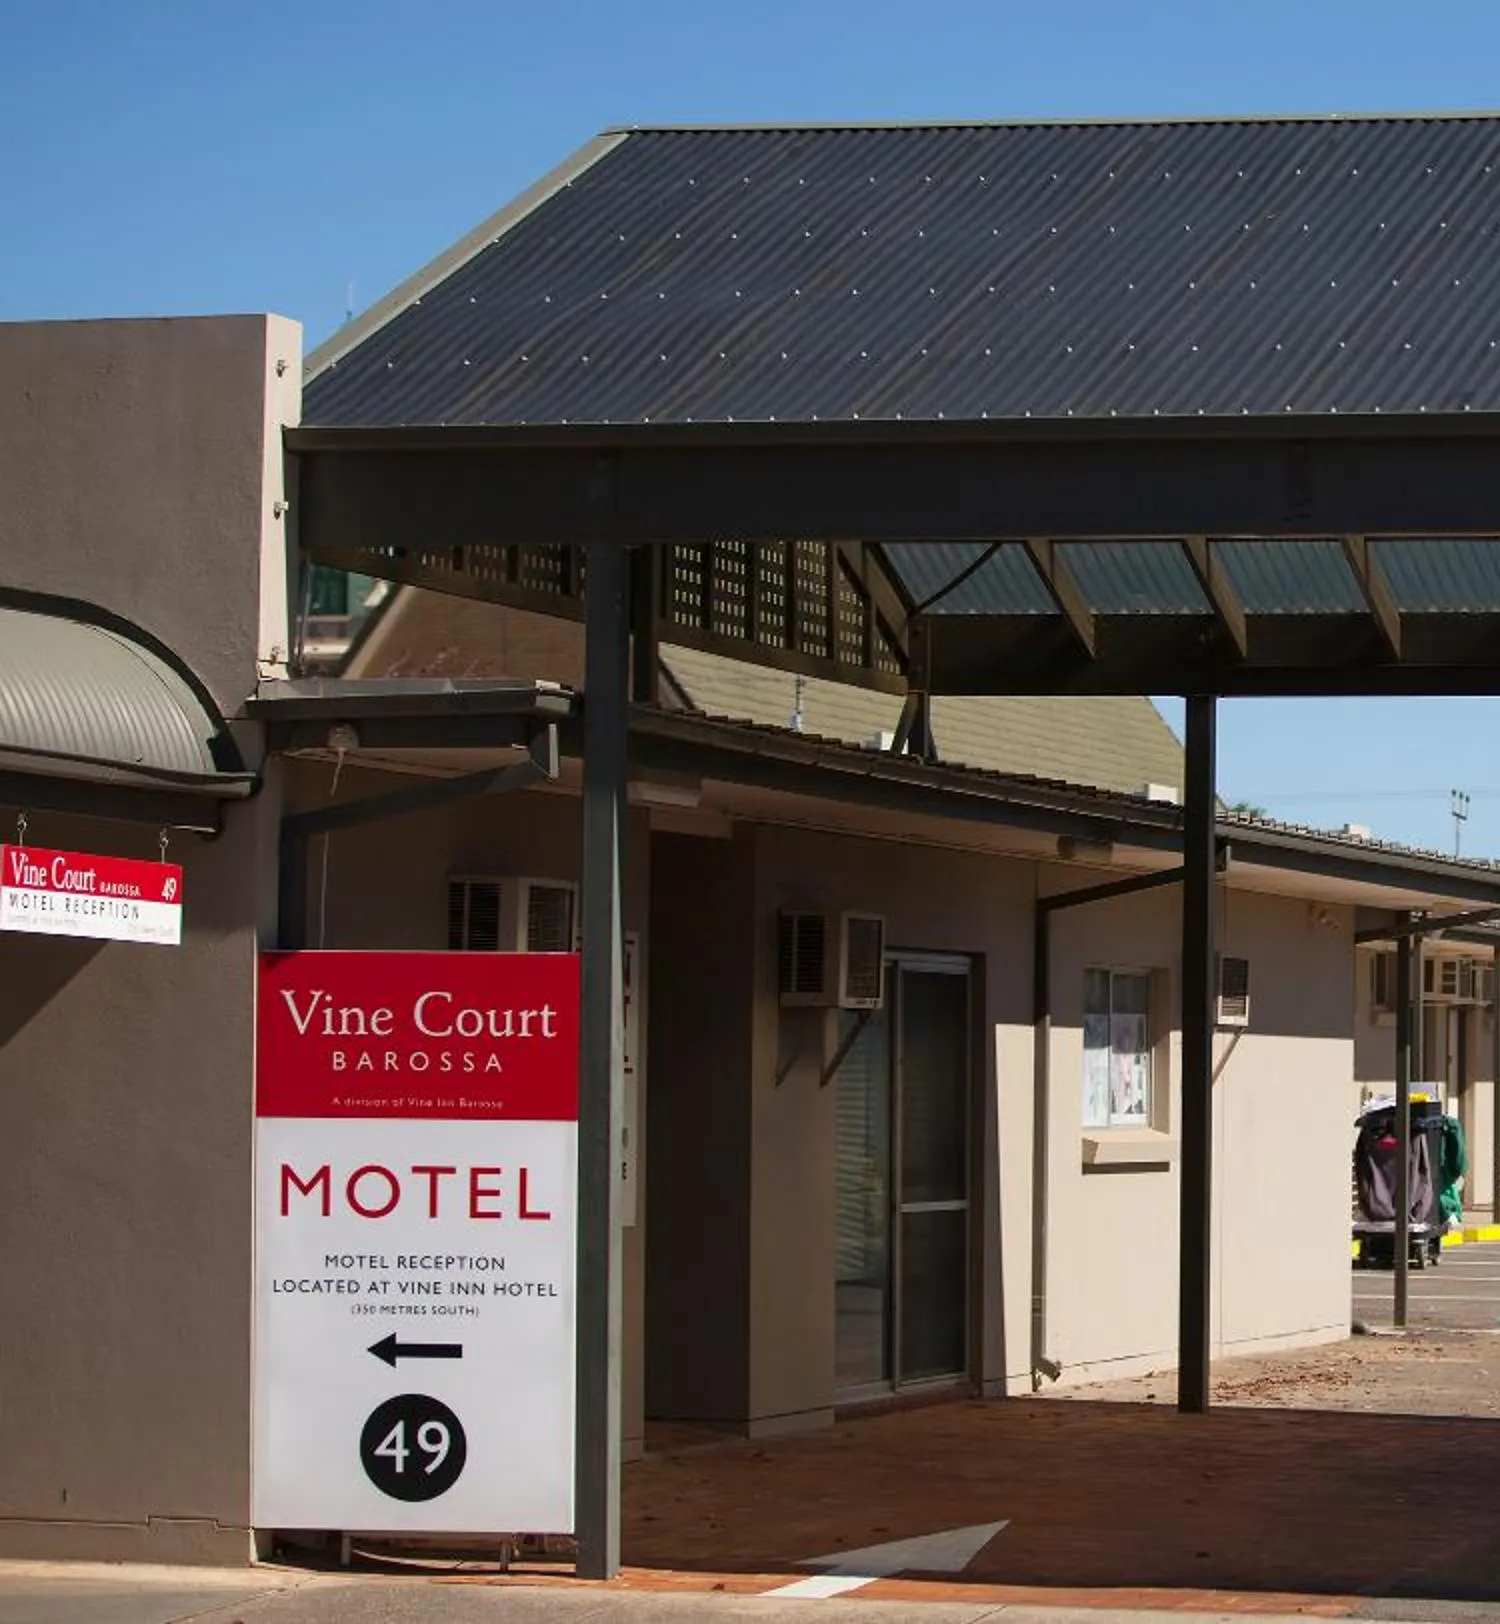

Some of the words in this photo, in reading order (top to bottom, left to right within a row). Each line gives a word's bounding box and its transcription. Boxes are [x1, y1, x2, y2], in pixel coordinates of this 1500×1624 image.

[11, 852, 47, 887] Vine
[52, 857, 96, 892] Court
[101, 881, 141, 897] BAROSSA
[161, 877, 177, 901] 49
[9, 893, 55, 911] MOTEL
[65, 897, 140, 920] RECEPTION
[280, 989, 393, 1035] Vine
[413, 991, 557, 1038] Court
[332, 1051, 503, 1073] BAROSSA
[331, 1097, 341, 1106] A
[344, 1098, 388, 1108] division
[392, 1098, 404, 1107] of
[407, 1097, 433, 1108] Vine
[437, 1098, 456, 1109] Inn
[459, 1098, 504, 1111] Barossa
[280, 1164, 551, 1219] MOTEL
[324, 1255, 389, 1269] MOTEL
[397, 1255, 505, 1271] RECEPTION
[273, 1279, 361, 1293] LOCATED
[367, 1280, 391, 1294] AT
[398, 1281, 441, 1294] VINE
[450, 1281, 485, 1295] INN
[493, 1283, 557, 1297] HOTEL
[380, 1305, 427, 1315] METRES
[431, 1306, 480, 1317] SOUTH)
[374, 1420, 450, 1475] 49
